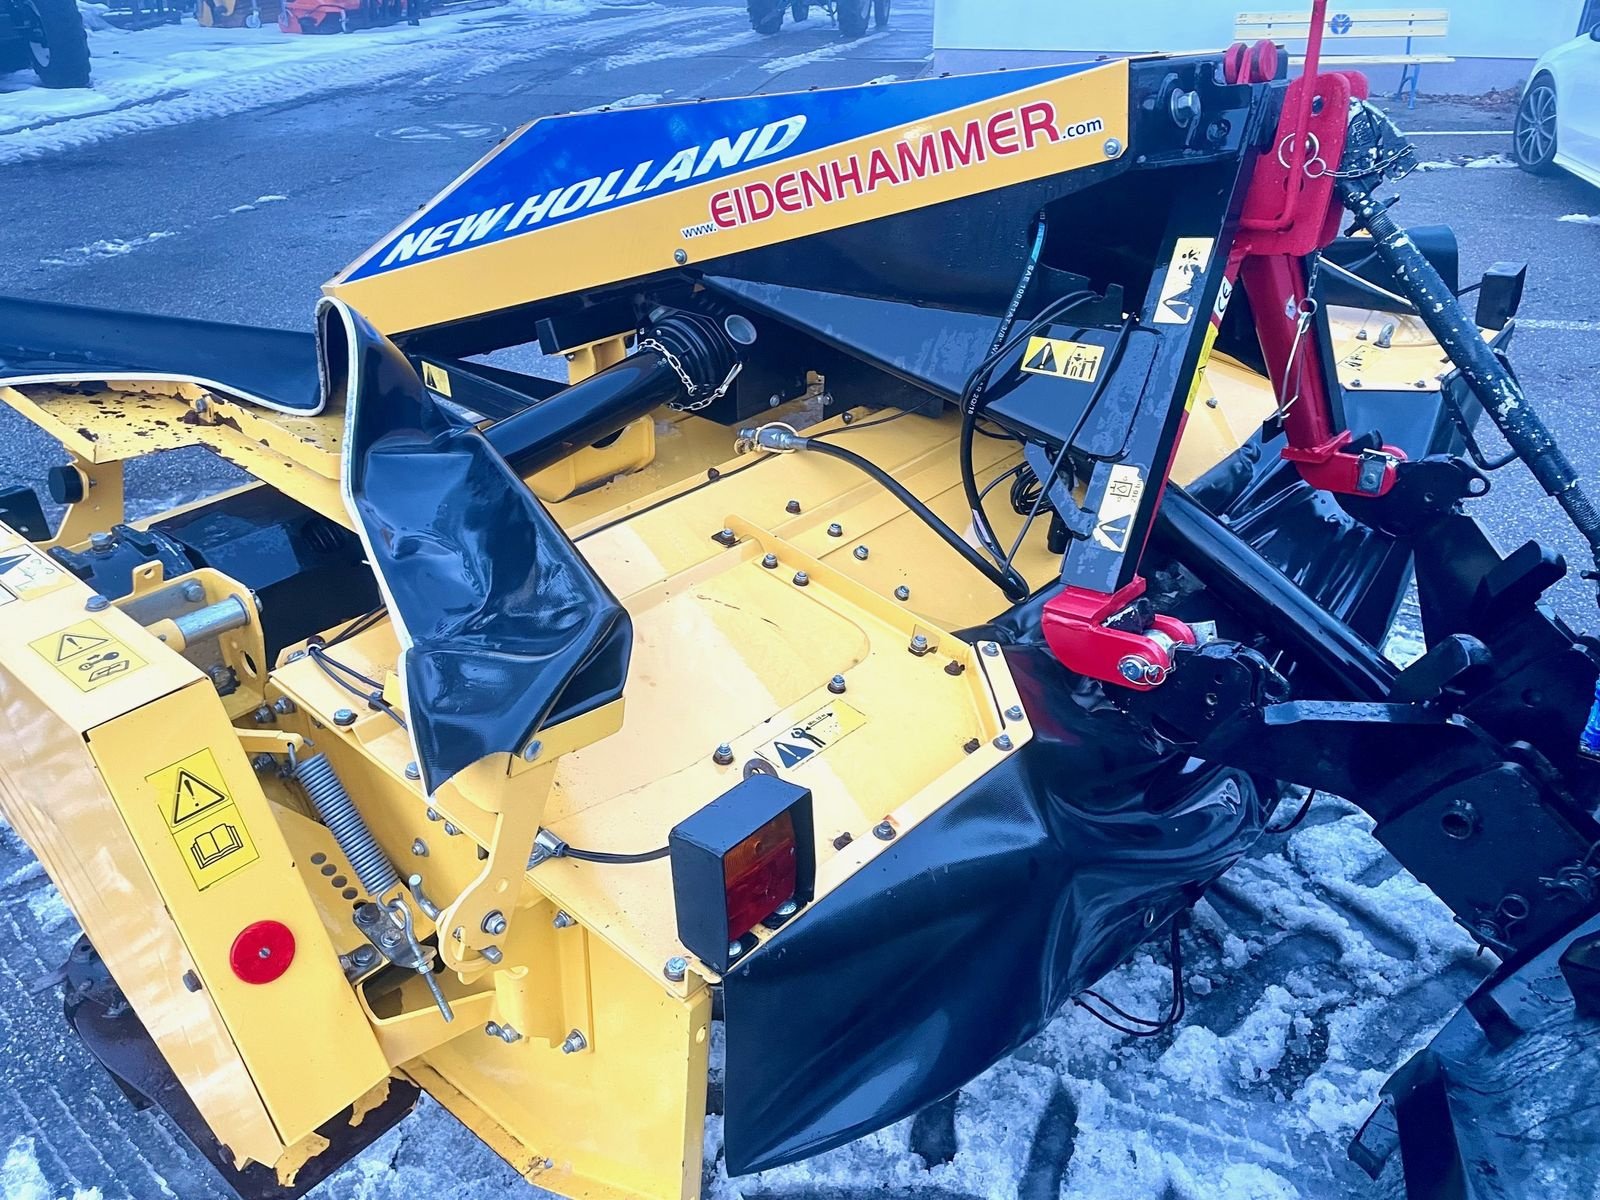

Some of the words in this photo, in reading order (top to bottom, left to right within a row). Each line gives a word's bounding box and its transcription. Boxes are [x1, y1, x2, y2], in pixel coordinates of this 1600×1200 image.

[682, 103, 1102, 238] www.EIDENHAMMER.com
[380, 203, 513, 267] NEW
[504, 114, 807, 231] HOLLAND
[1024, 265, 1034, 282] SAE
[1016, 285, 1026, 299] 100
[1005, 301, 1019, 324] R1AT
